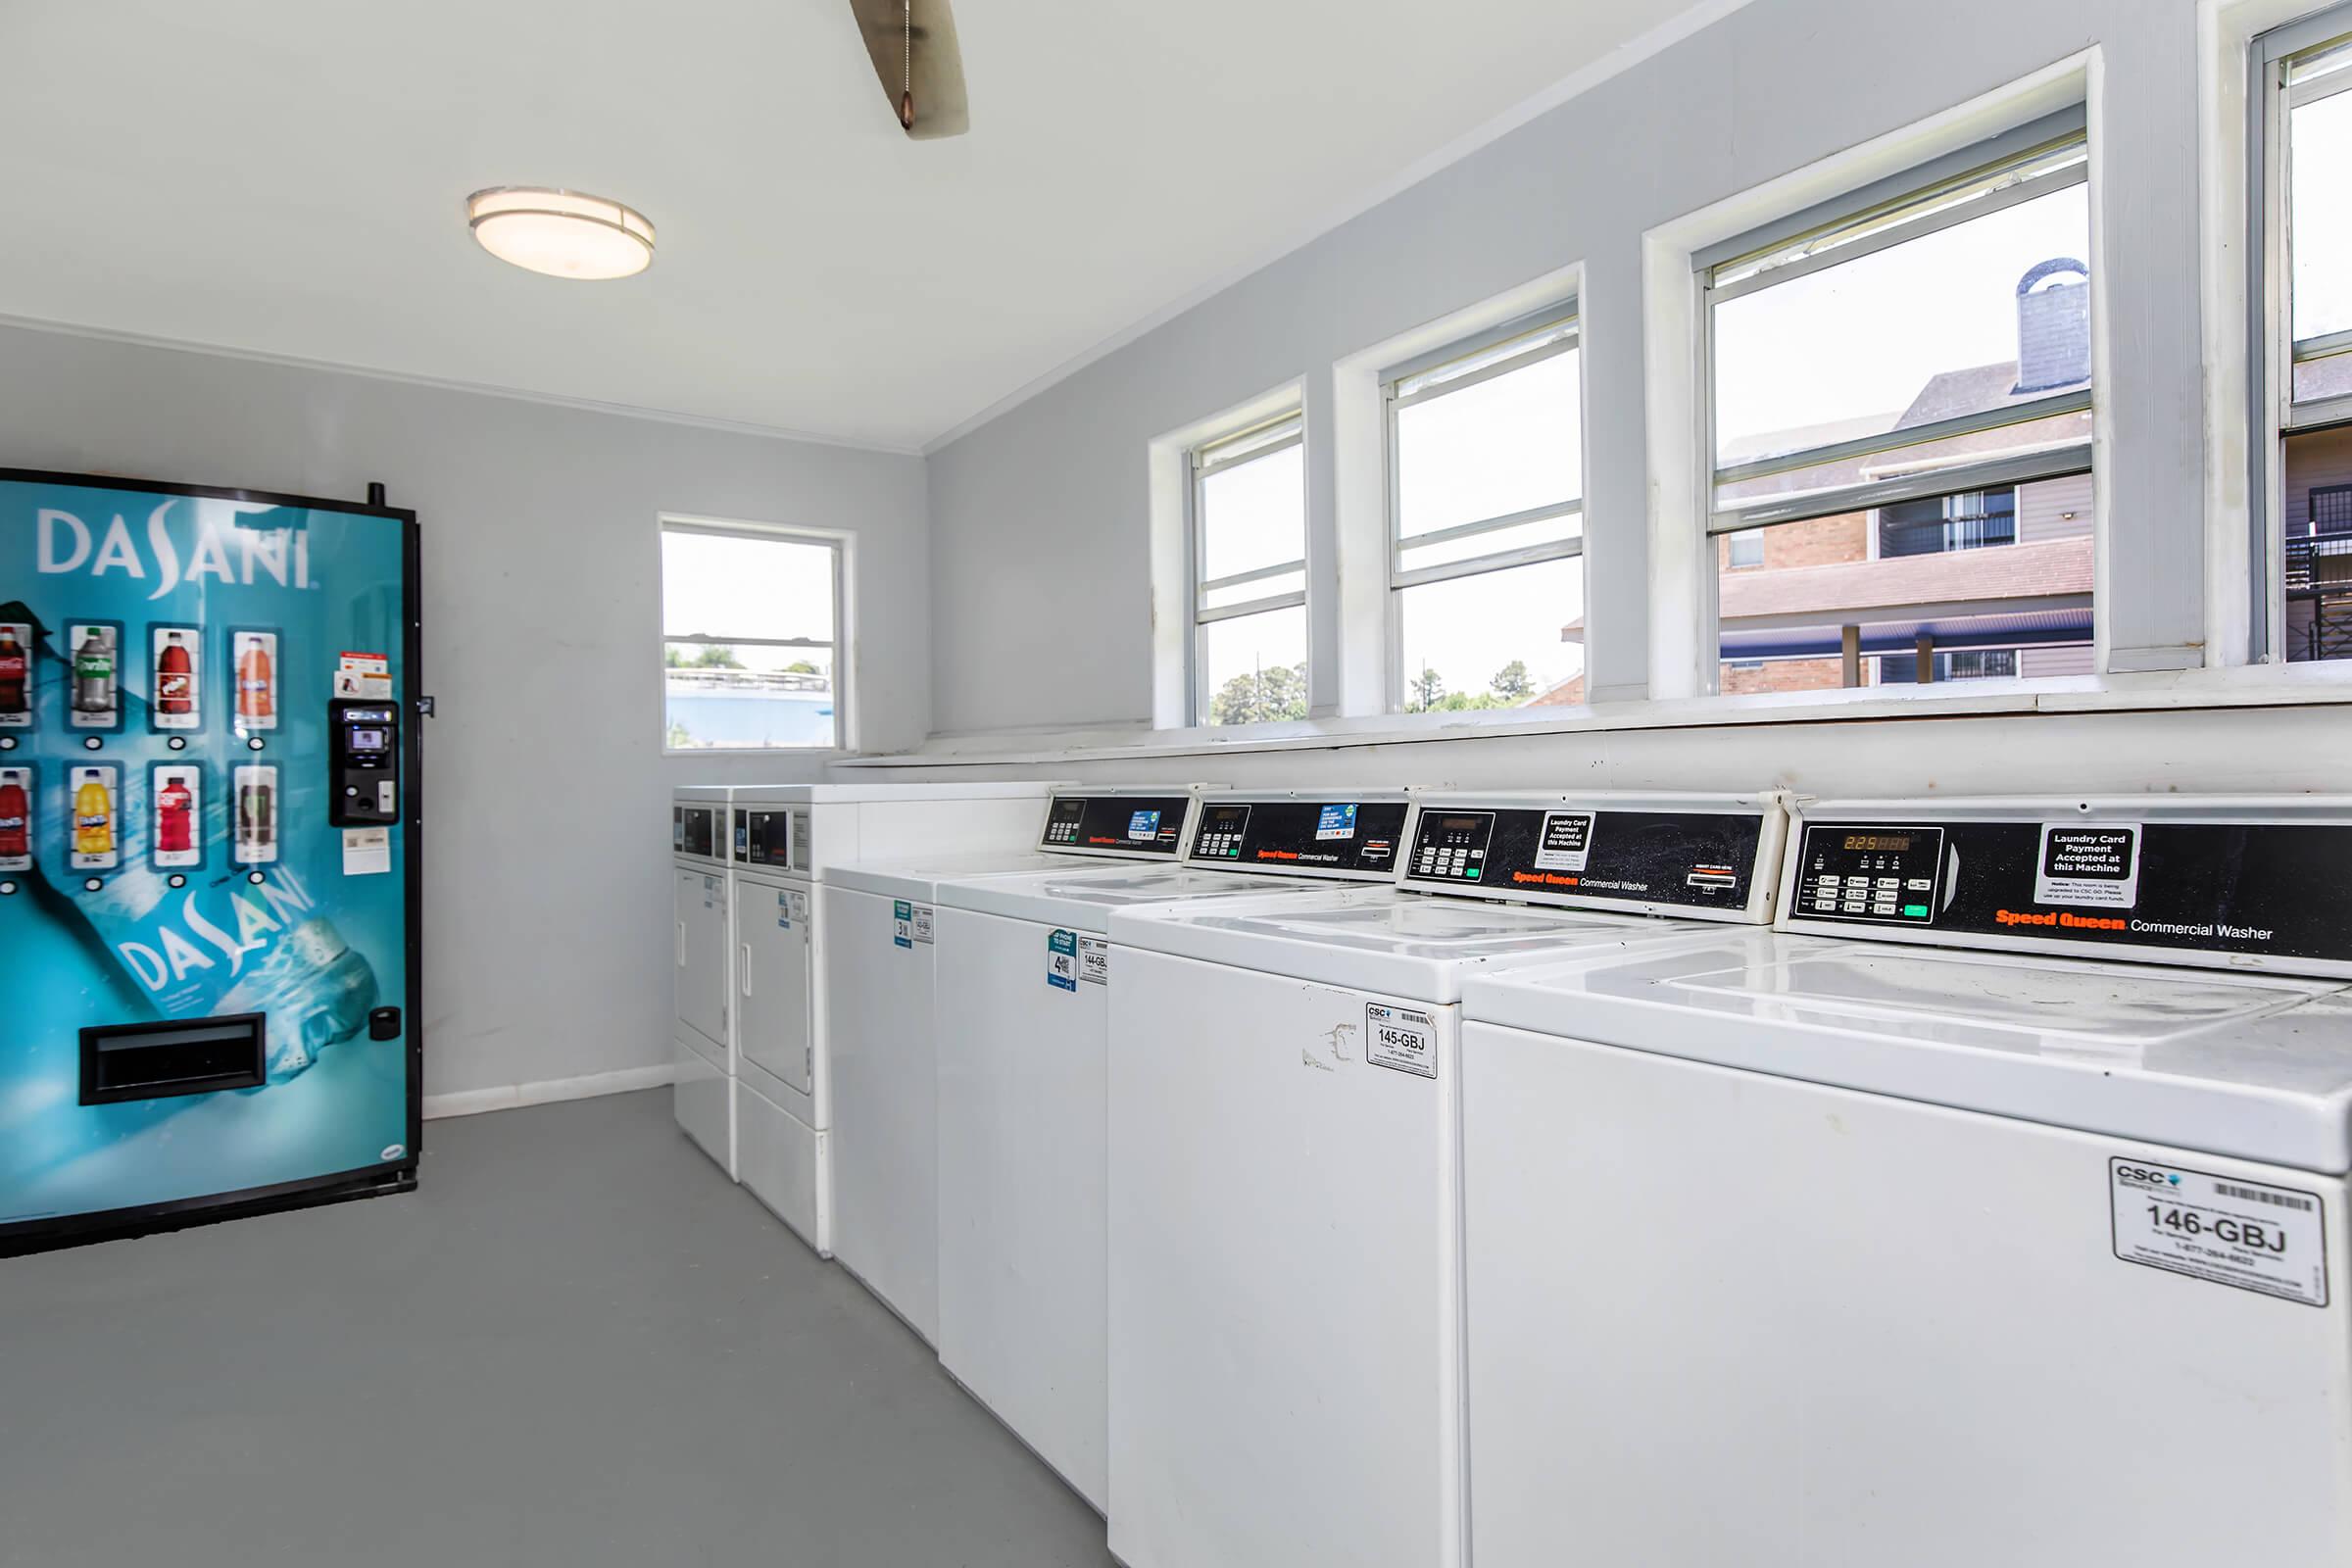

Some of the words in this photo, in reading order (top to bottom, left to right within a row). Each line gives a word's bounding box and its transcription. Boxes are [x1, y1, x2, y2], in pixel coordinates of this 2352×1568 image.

[37, 499, 310, 601] DASANI
[2054, 834, 2097, 844] Laundry
[2099, 835, 2126, 844] Card
[2065, 844, 2113, 854] Payment
[2053, 862, 2074, 871] this
[2076, 863, 2121, 873] Machine
[2055, 854, 2106, 863] Accepted
[1512, 871, 1544, 883] Speed
[1545, 873, 1579, 886] Queen
[1580, 878, 1620, 890] Commercial
[1621, 880, 1648, 891] Washer
[118, 862, 316, 993] DASANI
[1995, 908, 2056, 926] Speed
[2059, 912, 2126, 930] Queen
[2131, 919, 2213, 936] Commercial
[2217, 924, 2273, 940] Washer
[1369, 1007, 1385, 1016] CSC
[1379, 1029, 1425, 1051] 145-GBJ
[2117, 1166, 2164, 1183] CSC
[2147, 1205, 2285, 1252] 146-GBJ
